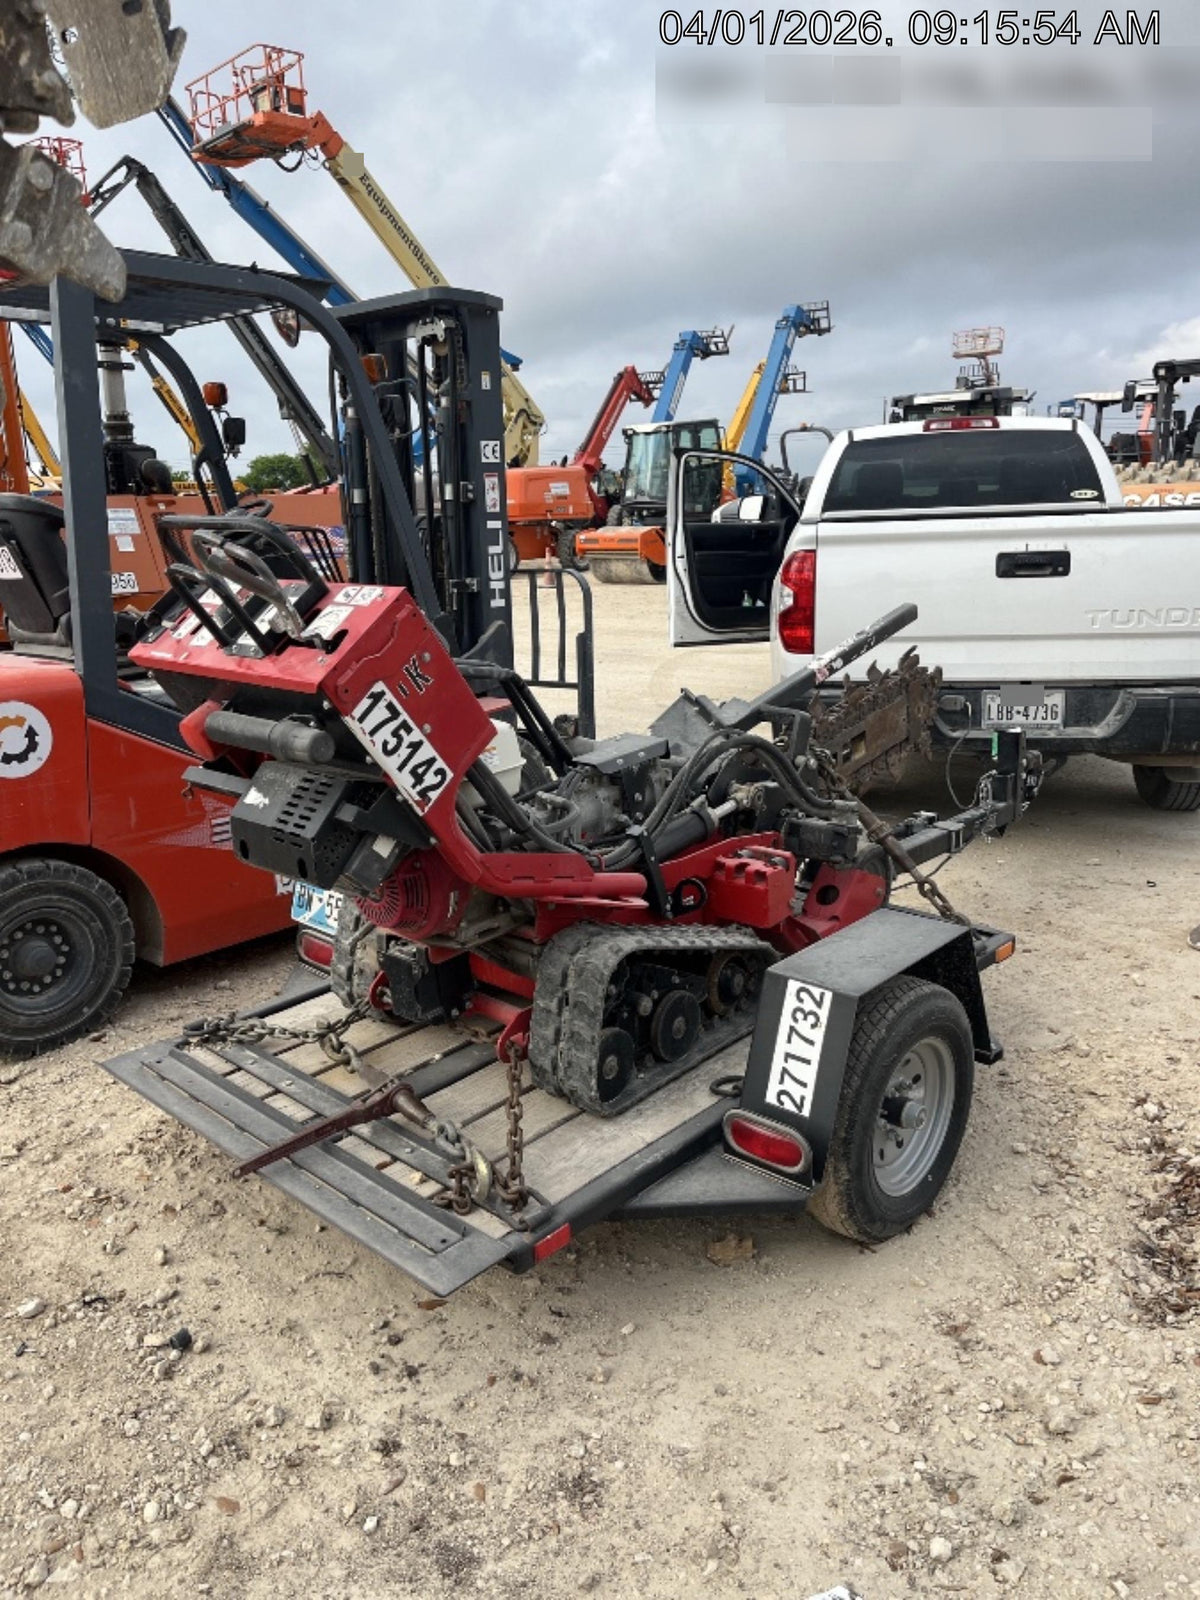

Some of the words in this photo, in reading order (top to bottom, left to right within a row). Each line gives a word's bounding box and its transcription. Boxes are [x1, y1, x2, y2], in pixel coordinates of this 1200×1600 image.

[358, 172, 441, 285] EquipmentShare
[483, 443, 499, 459] CE
[486, 520, 506, 608] HELI
[357, 688, 448, 806] 175142
[776, 986, 826, 1113] 271732
